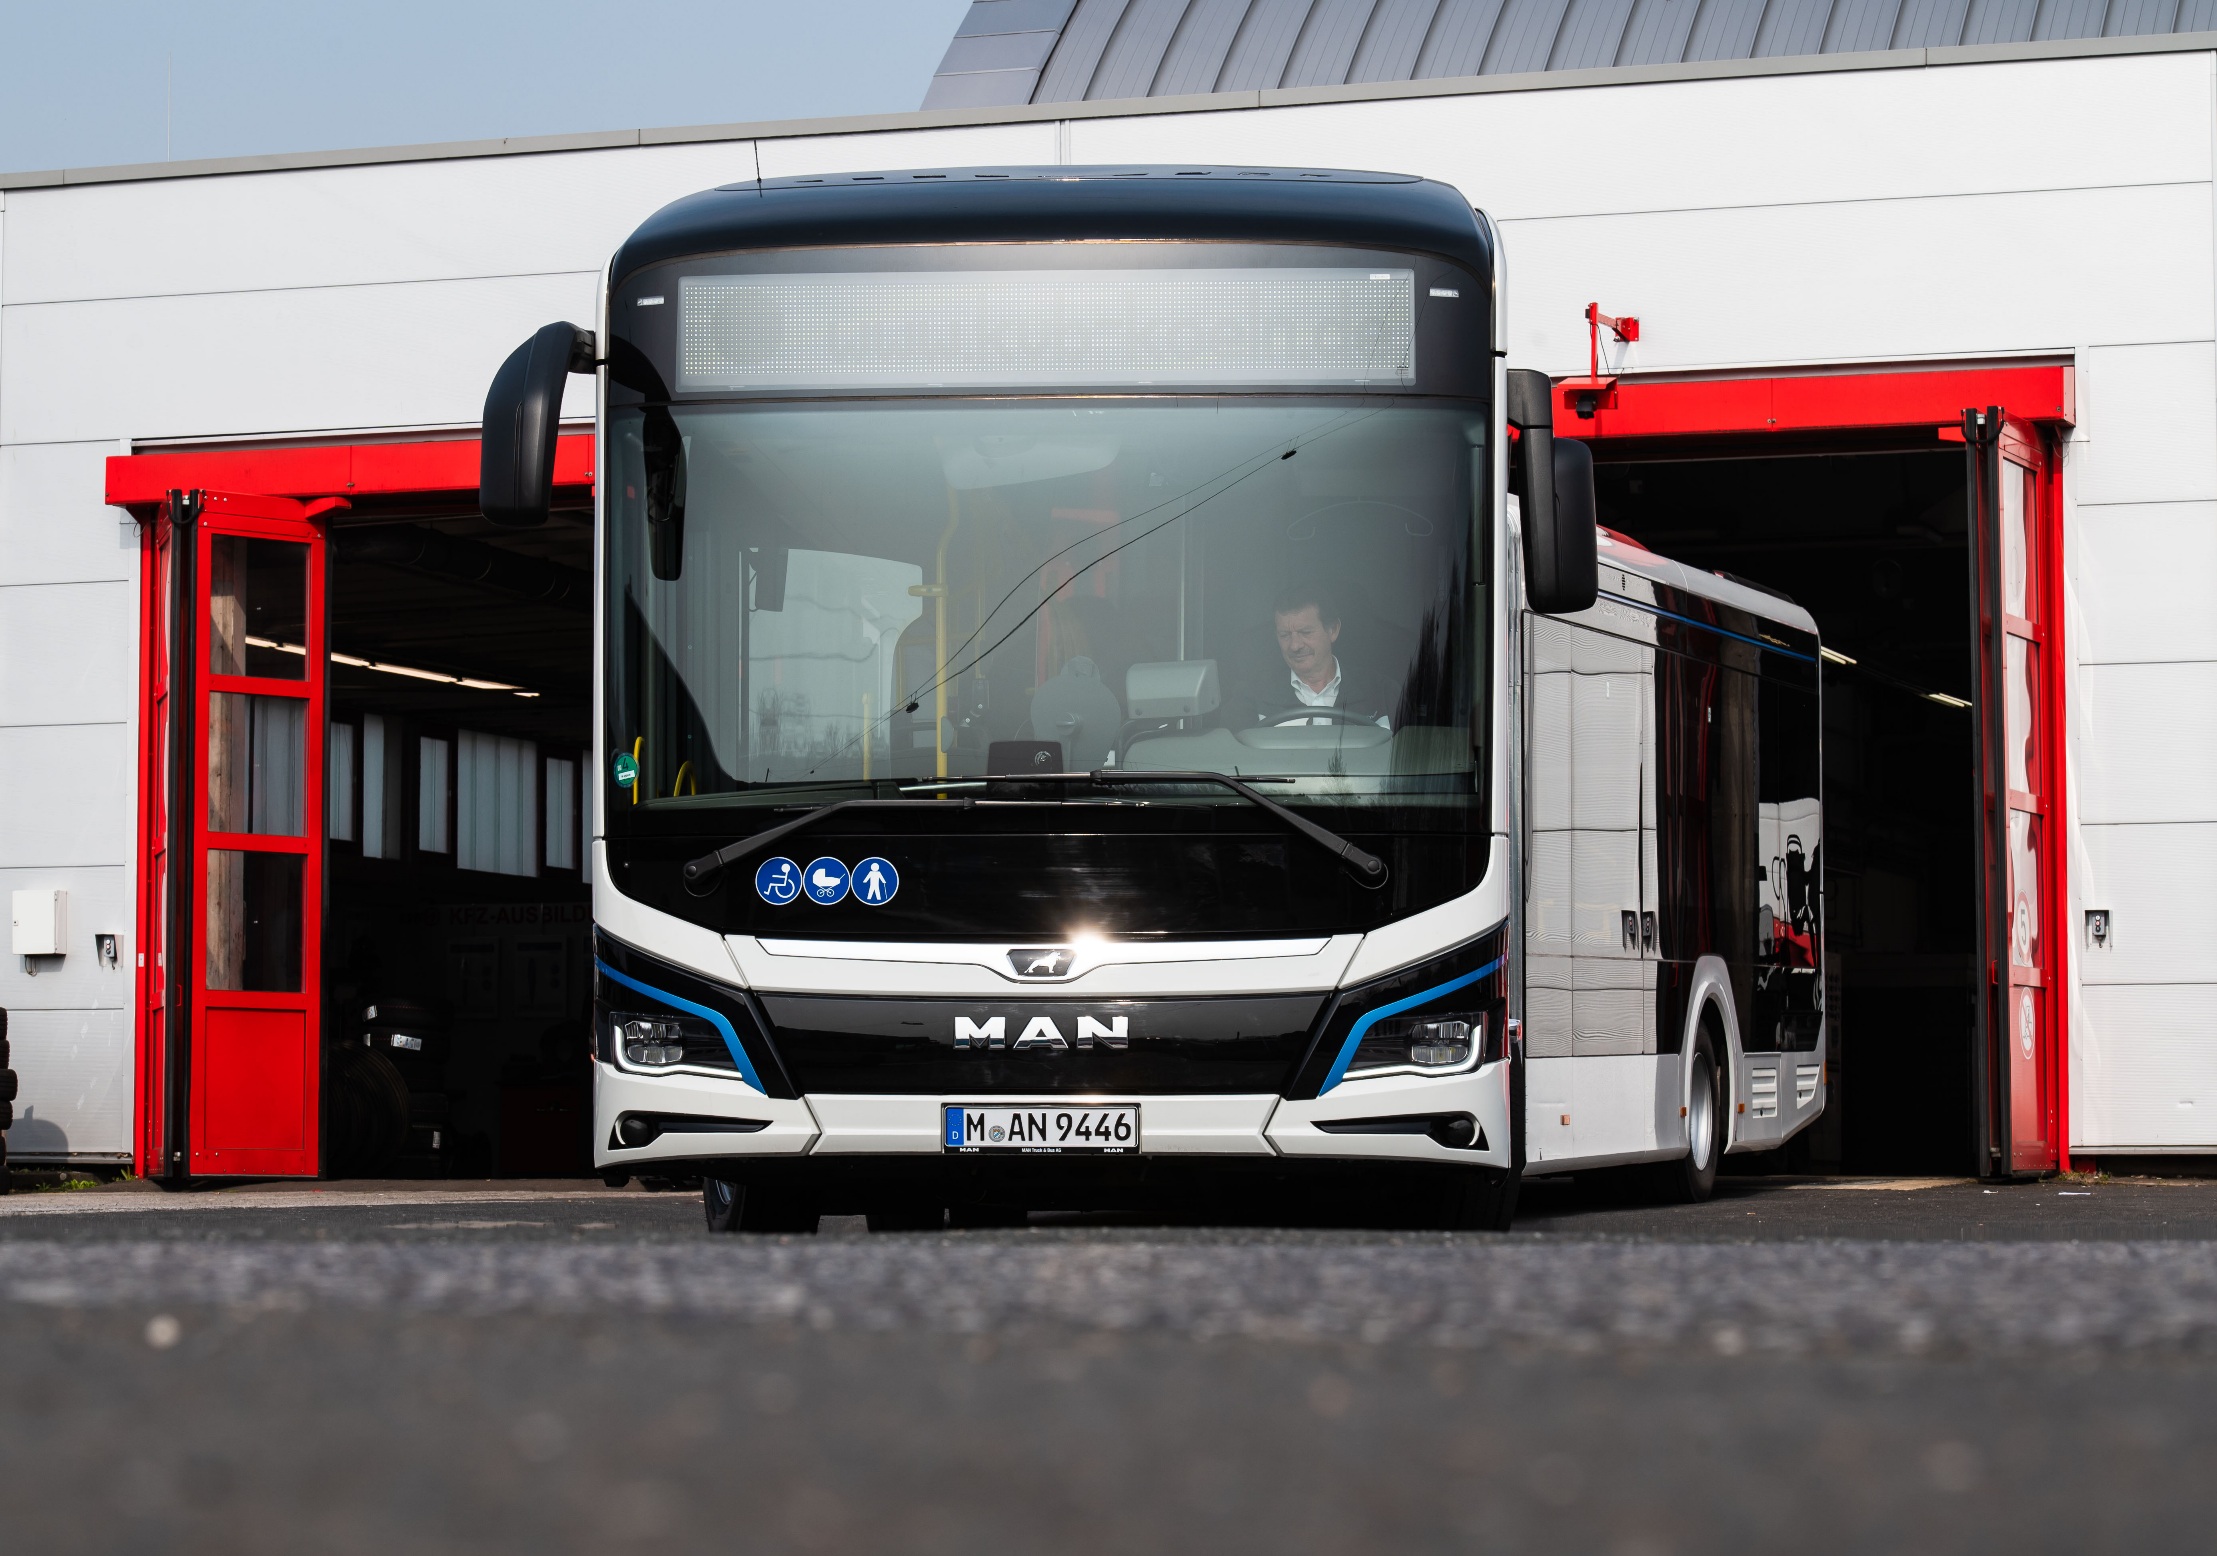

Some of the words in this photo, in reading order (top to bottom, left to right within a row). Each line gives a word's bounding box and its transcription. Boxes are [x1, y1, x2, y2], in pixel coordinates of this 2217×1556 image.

[953, 1016, 1129, 1050] MAN
[951, 1130, 959, 1140] D
[966, 1112, 985, 1141] M
[1007, 1112, 1047, 1141] AN
[1055, 1112, 1132, 1141] 9446
